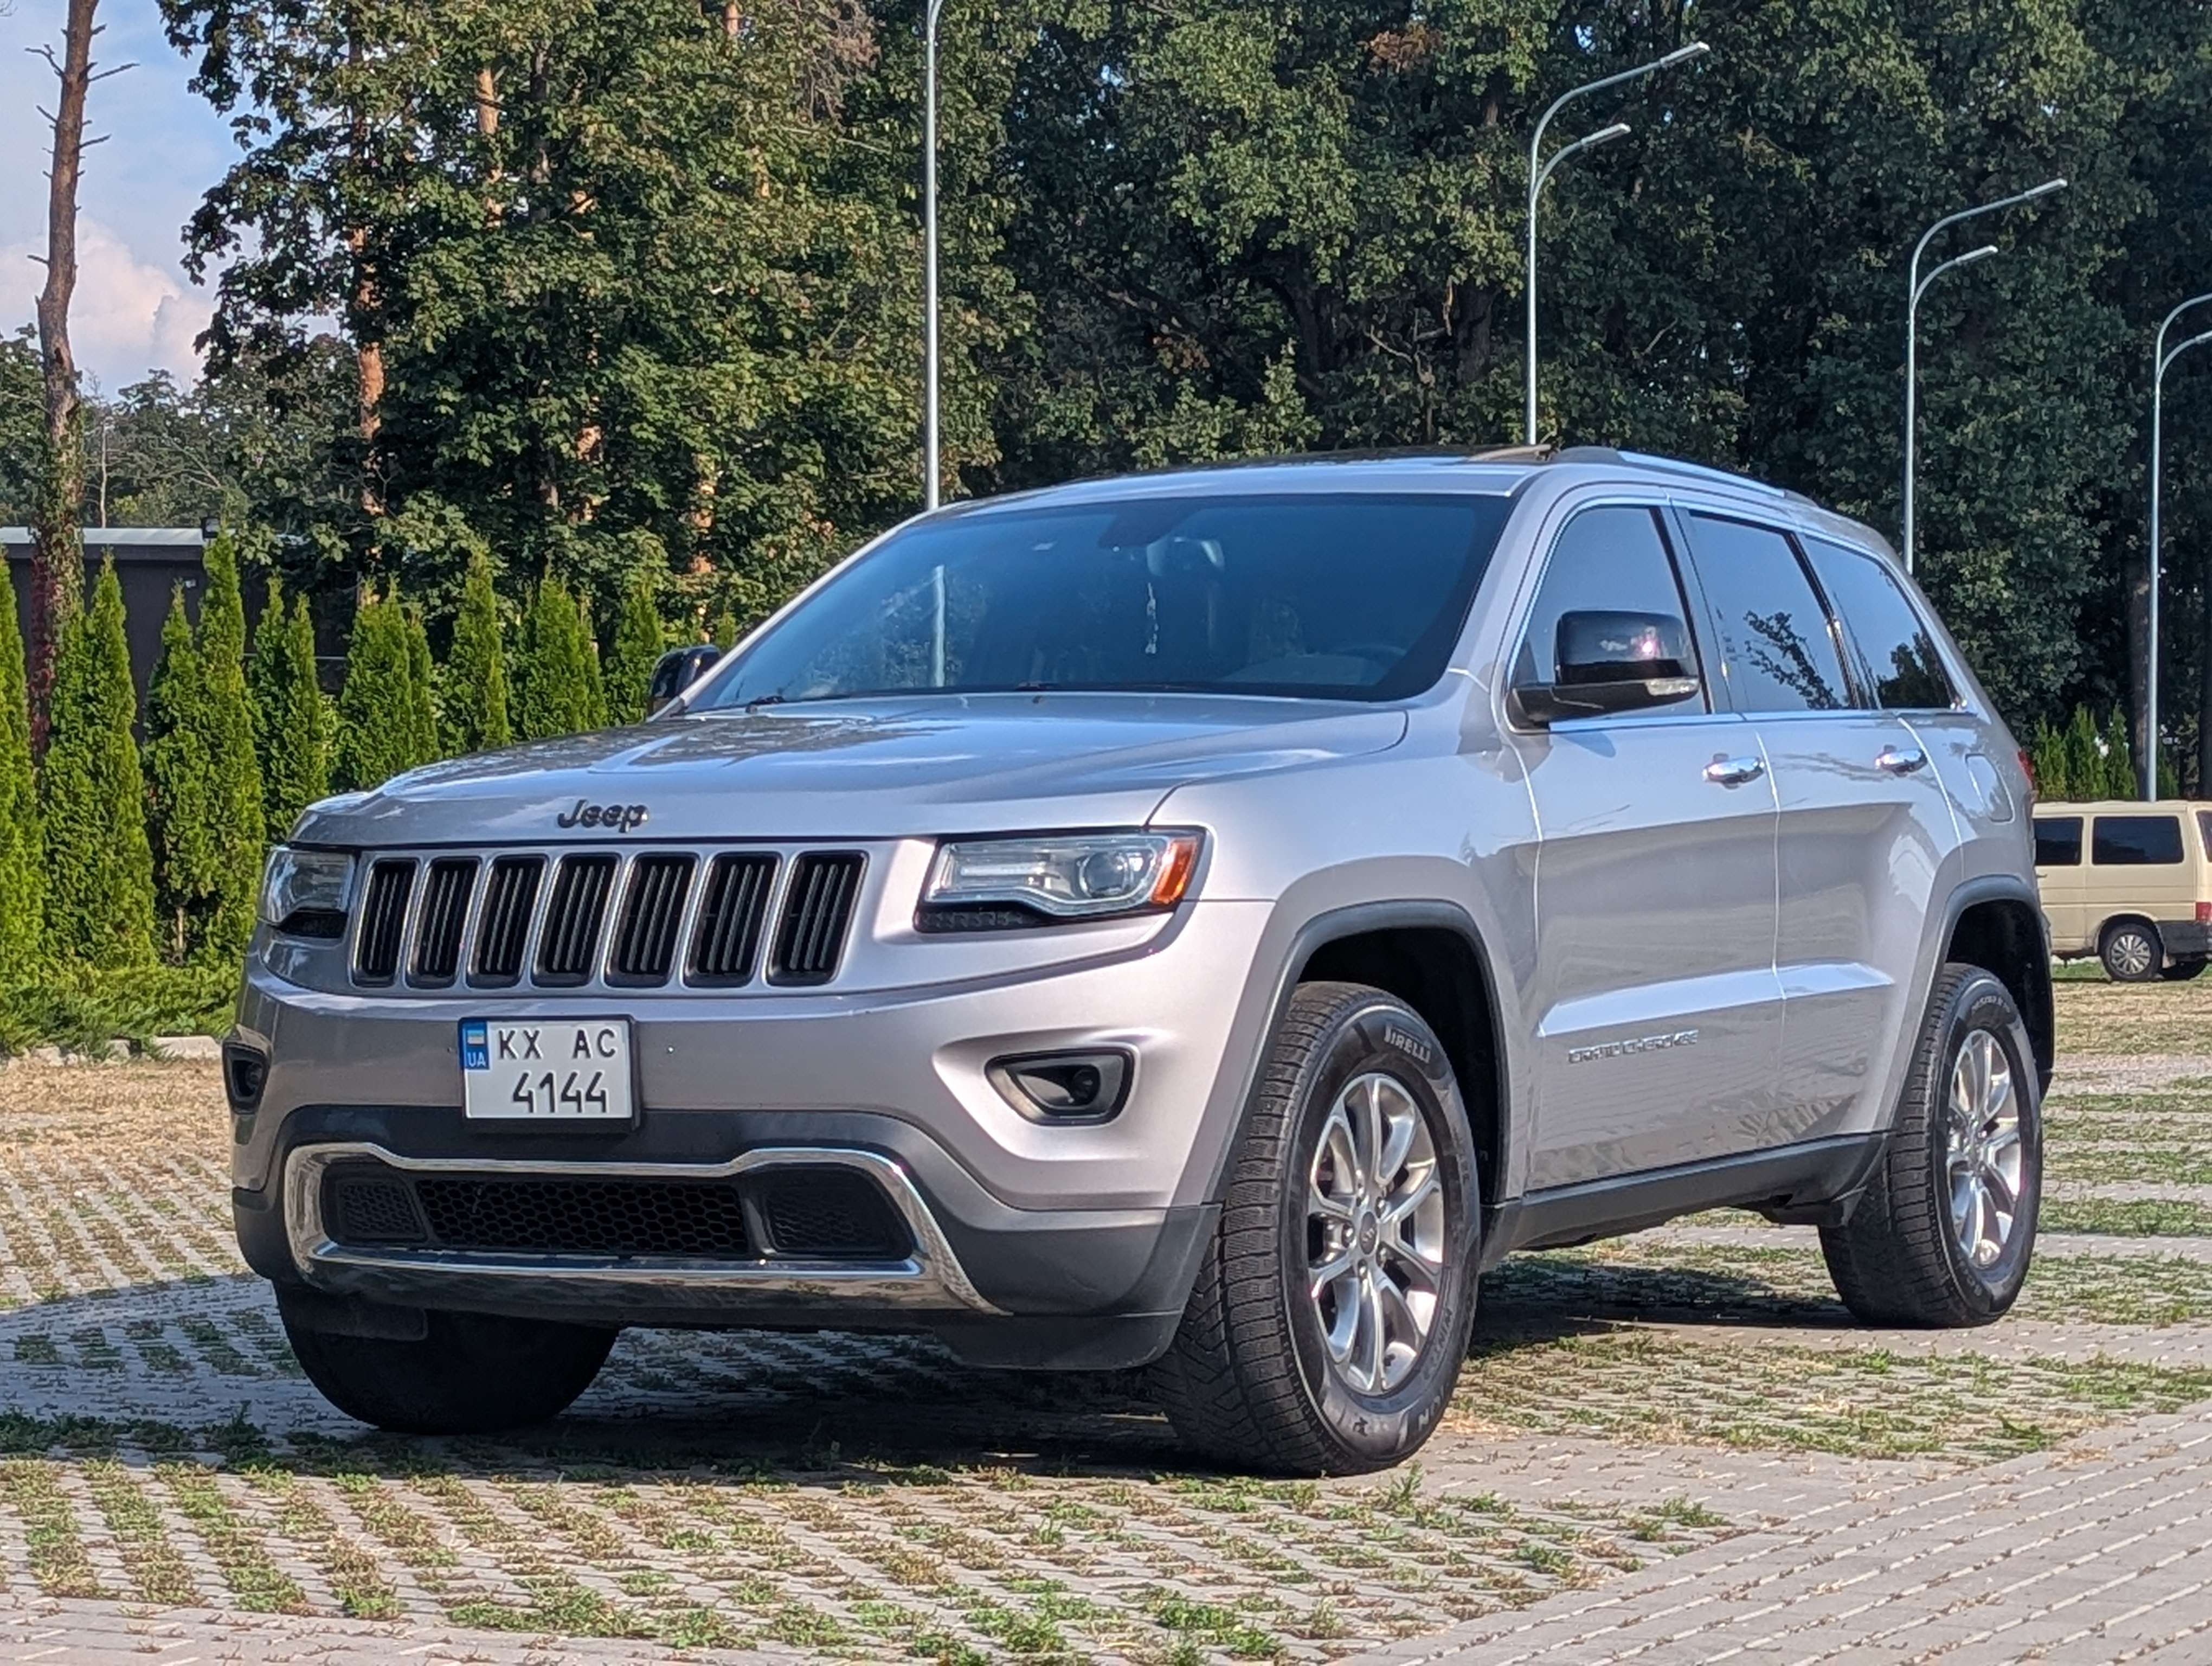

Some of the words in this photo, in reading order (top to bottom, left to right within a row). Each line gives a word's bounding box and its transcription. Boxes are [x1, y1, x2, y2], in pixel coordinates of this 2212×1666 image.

[557, 799, 649, 834] Jeep
[467, 1052, 487, 1068] UA
[498, 1029, 542, 1060] KX
[572, 1029, 616, 1059] AC
[1384, 1022, 1431, 1063] PIRELLI
[512, 1072, 607, 1113] 4144
